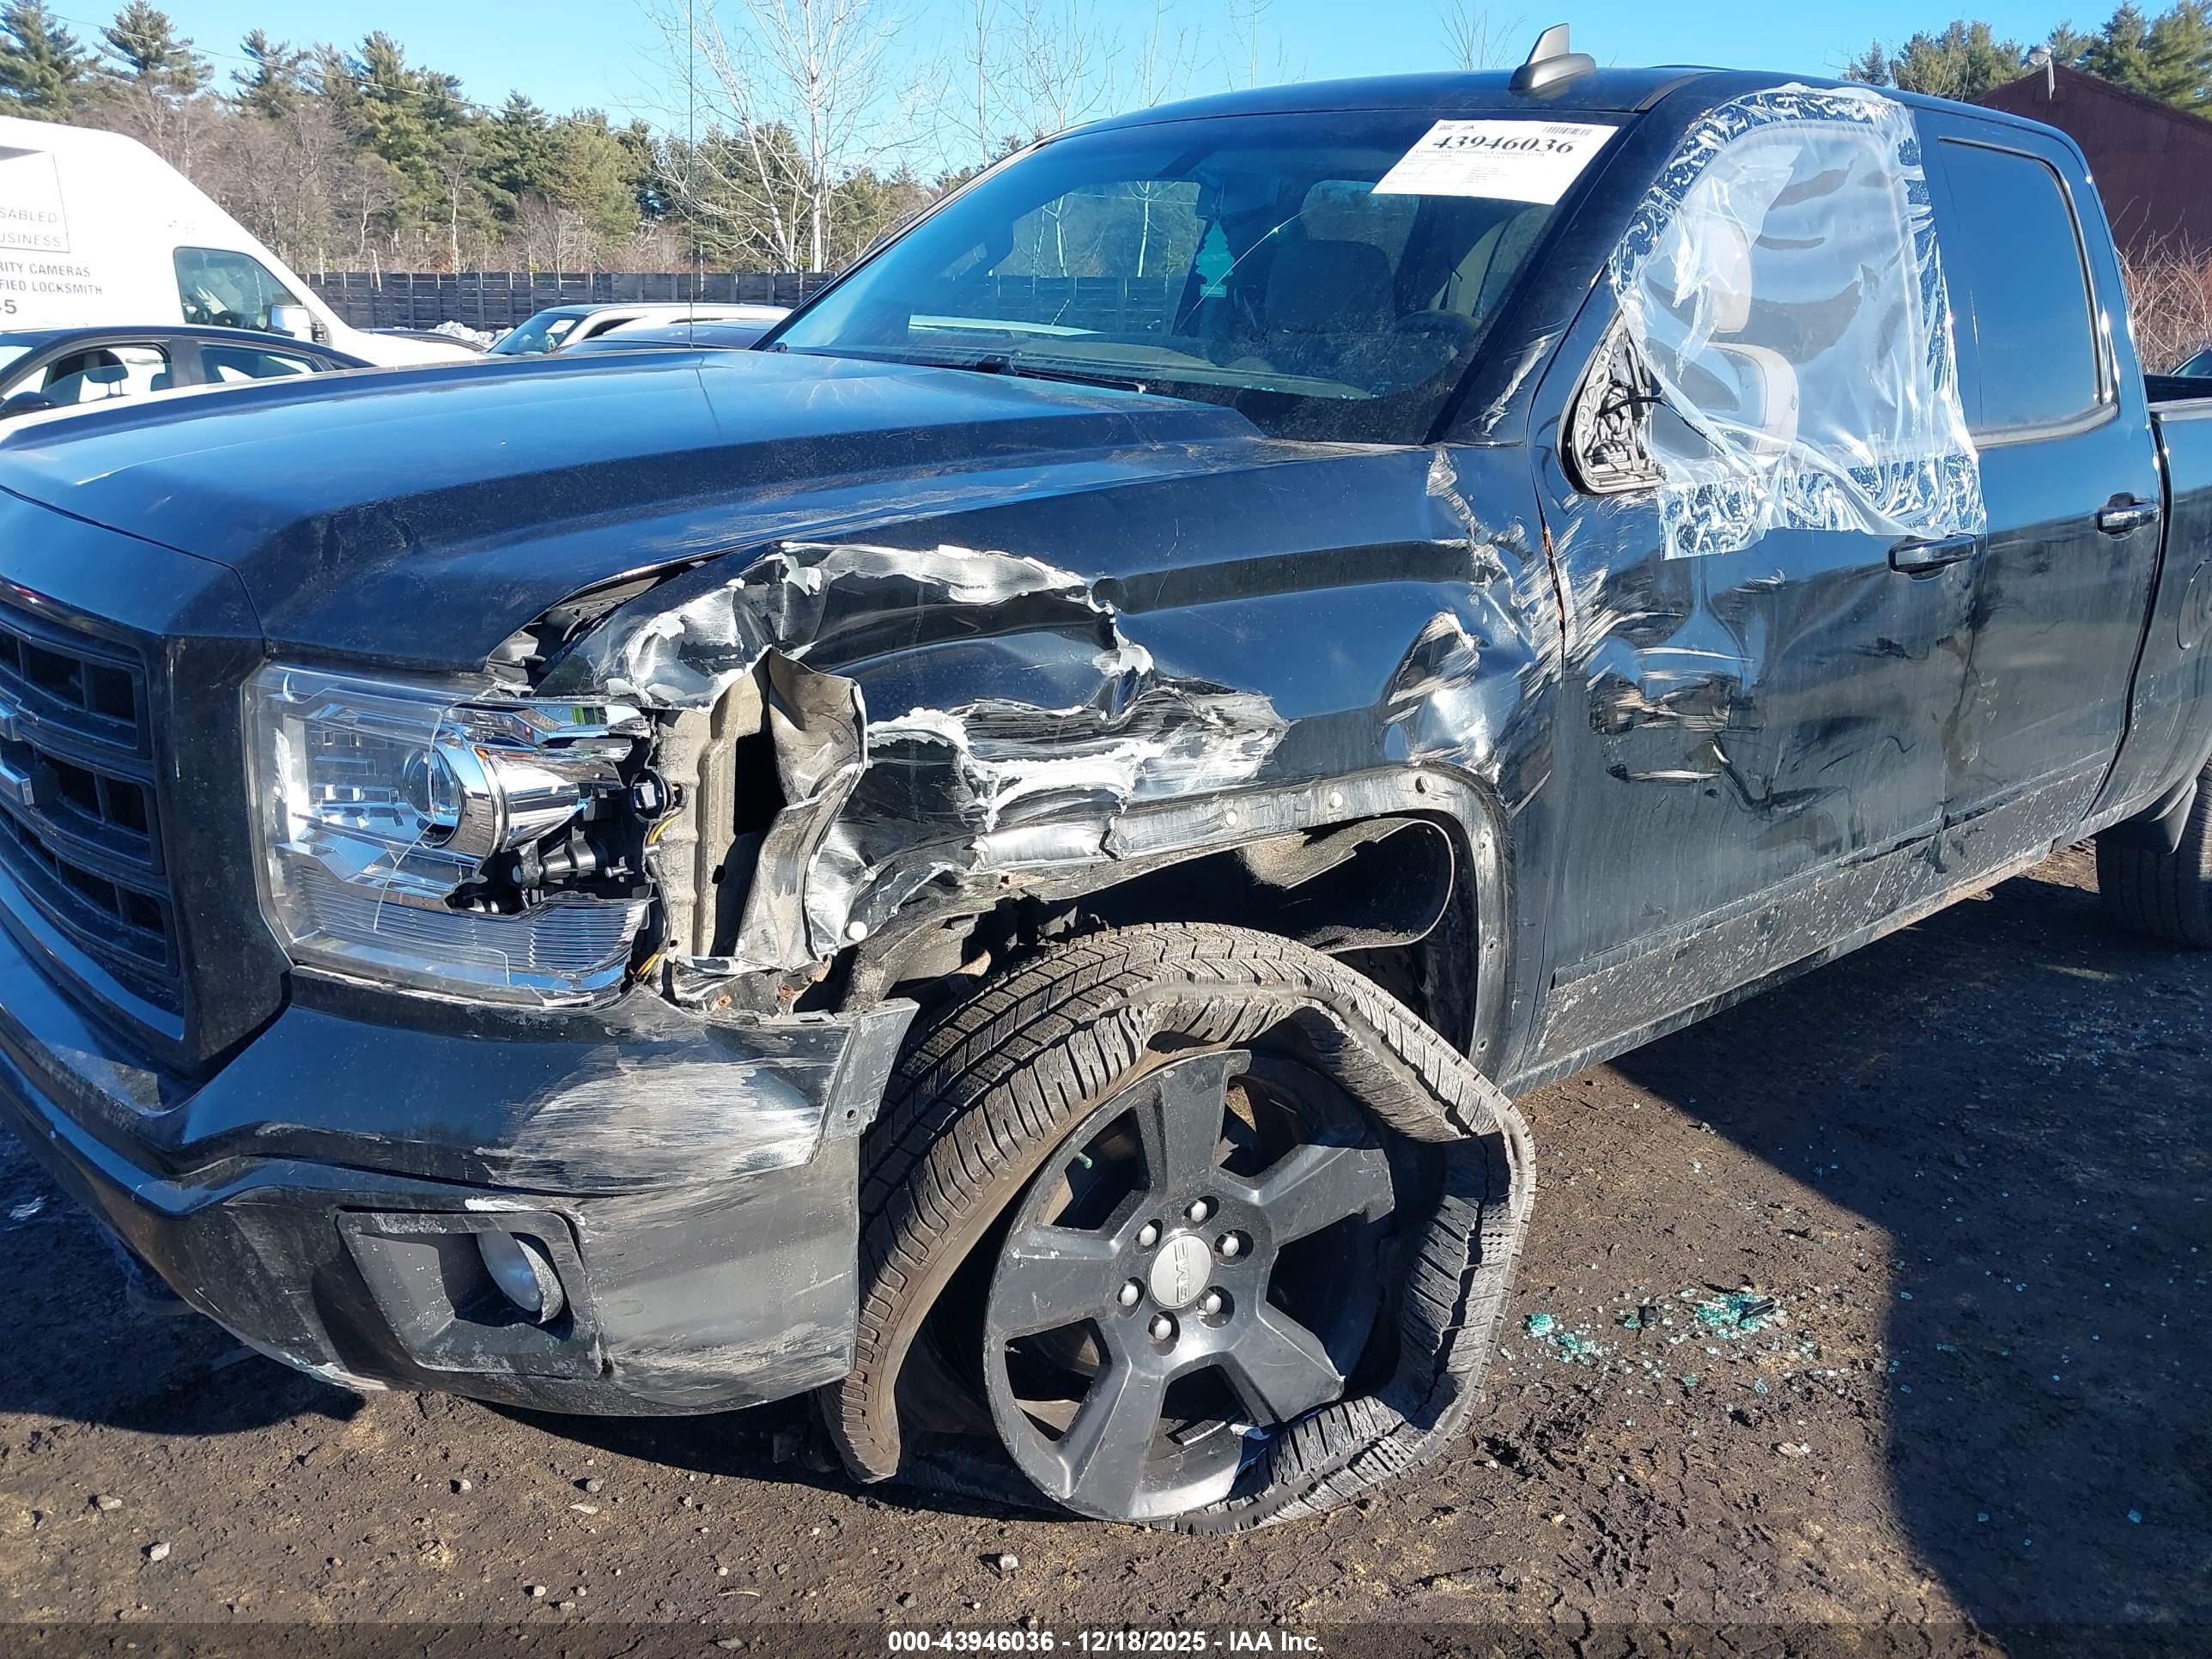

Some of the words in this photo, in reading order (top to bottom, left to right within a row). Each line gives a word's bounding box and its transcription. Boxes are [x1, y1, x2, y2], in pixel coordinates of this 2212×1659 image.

[1432, 135, 1579, 154] 43946036
[29, 263, 90, 277] CAMERAS
[32, 281, 103, 295] LOCKSMITH
[1174, 1243, 1189, 1304] GMC
